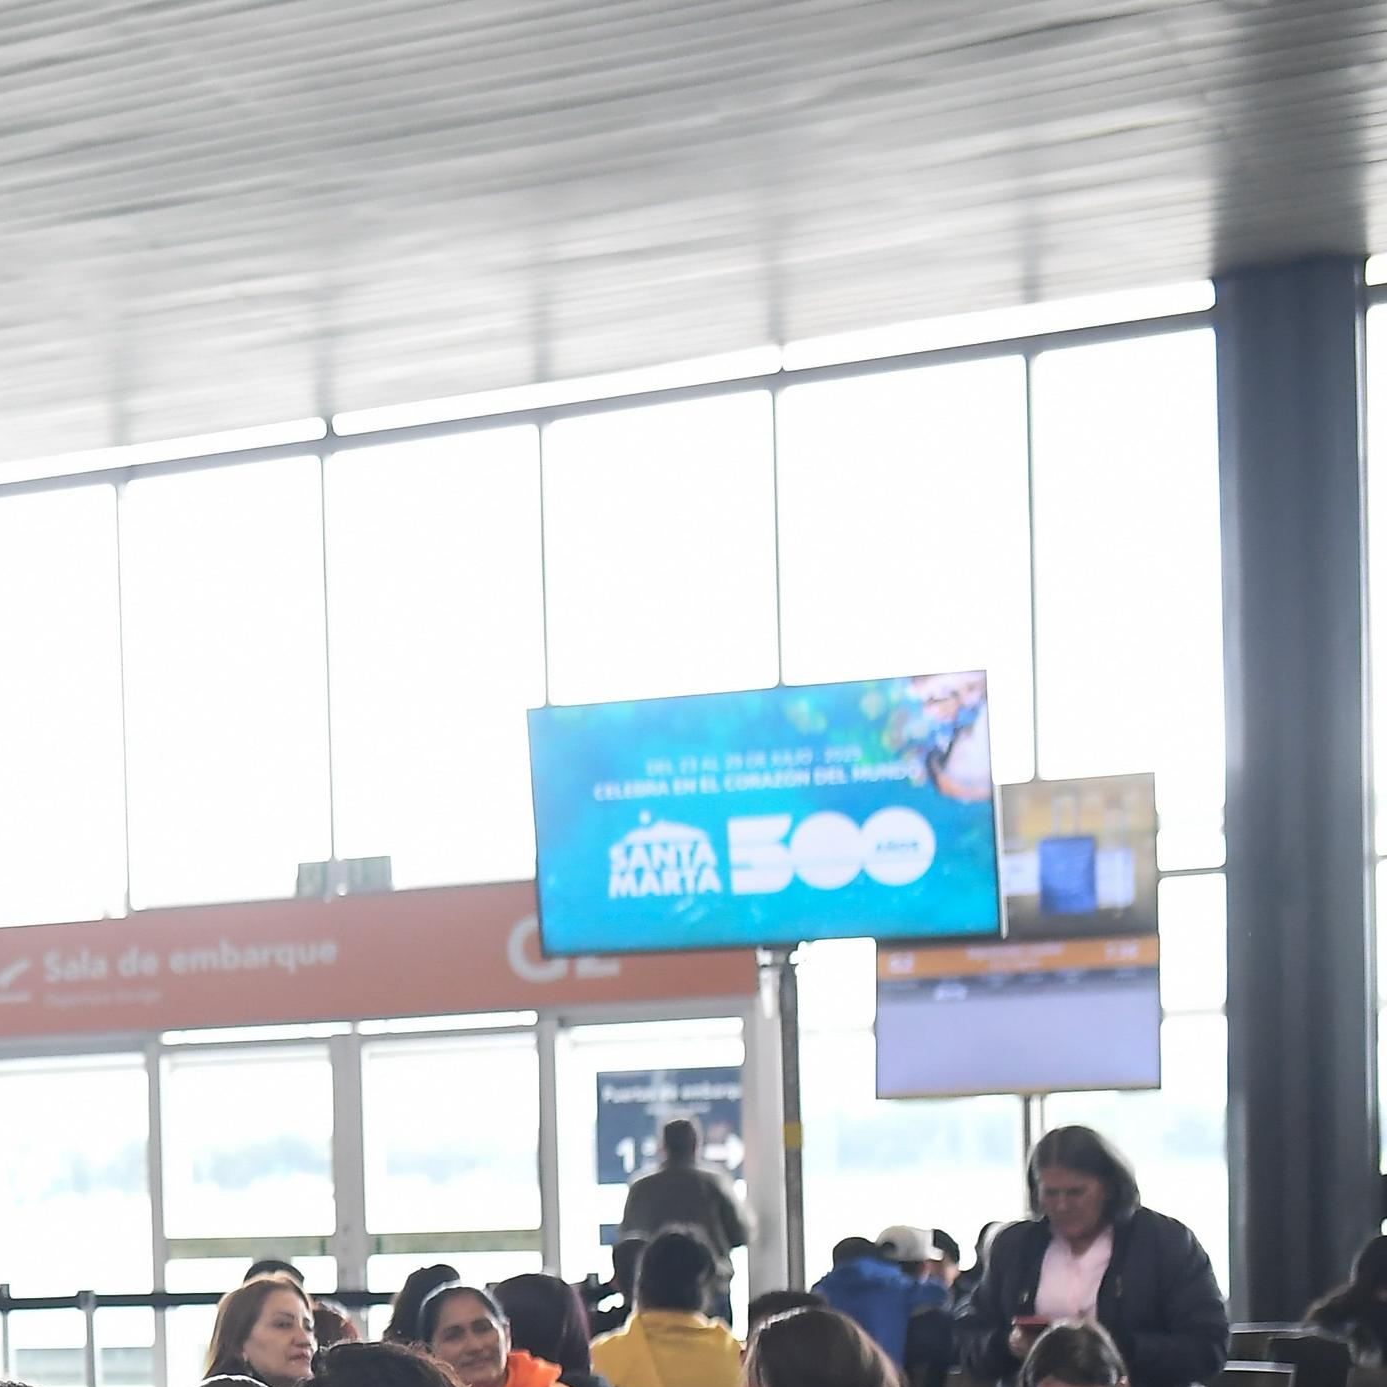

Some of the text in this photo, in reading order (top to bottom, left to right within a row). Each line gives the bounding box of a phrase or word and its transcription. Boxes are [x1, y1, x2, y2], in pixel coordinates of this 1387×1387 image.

[609, 842, 716, 873] SANTA
[608, 866, 722, 899] MARTA
[43, 938, 338, 983] Sala de embarque
[507, 911, 621, 984] G
